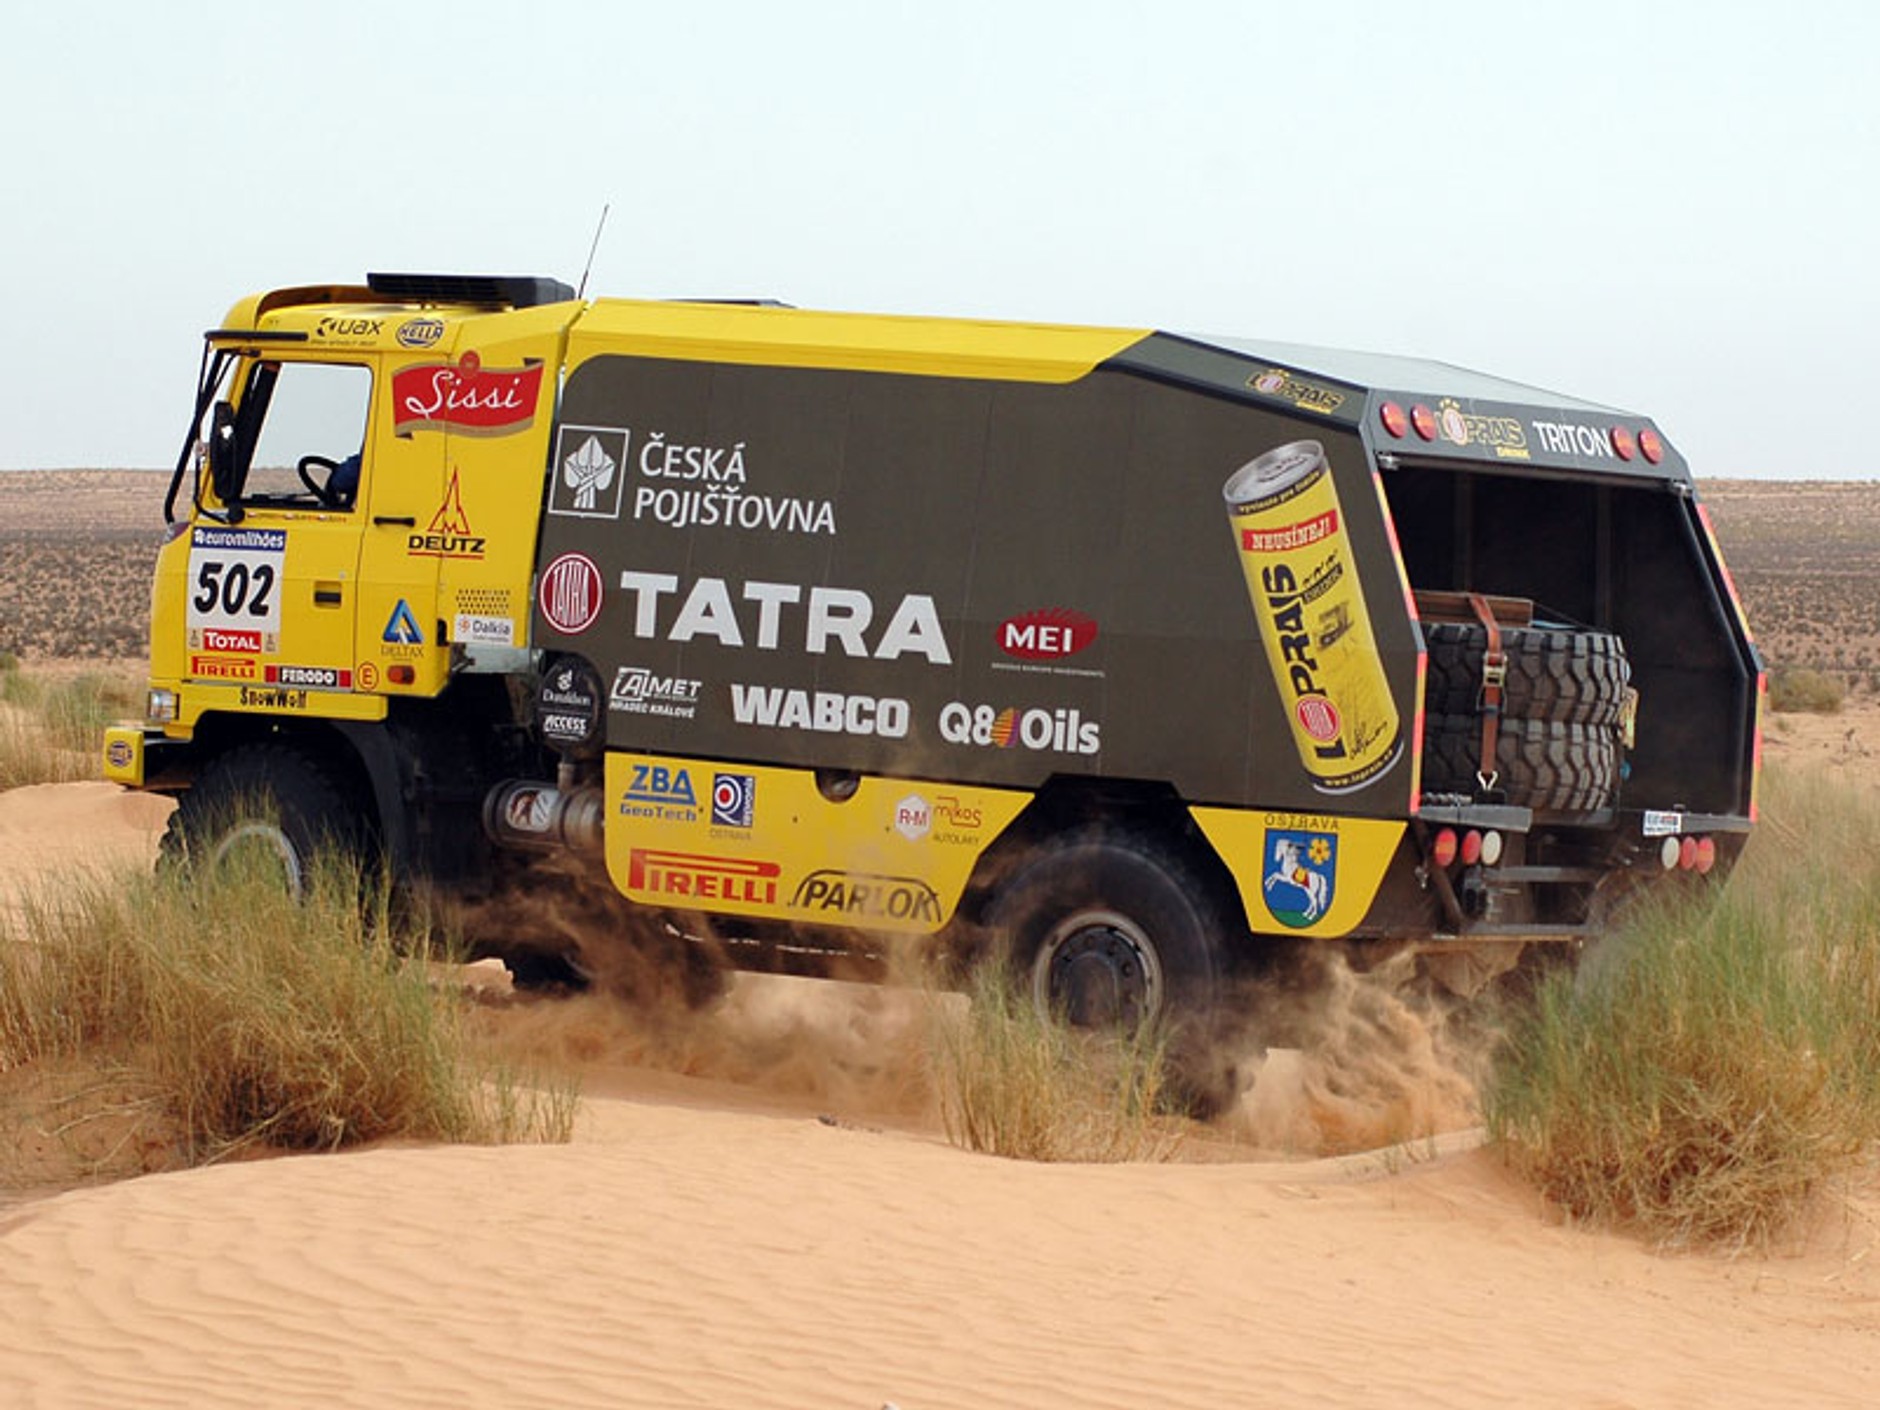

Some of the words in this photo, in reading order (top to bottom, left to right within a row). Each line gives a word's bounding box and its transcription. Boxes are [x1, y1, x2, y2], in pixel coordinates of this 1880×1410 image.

[405, 370, 523, 419] Sissi
[640, 432, 746, 484] ČESKÁ
[1532, 421, 1614, 457] TRITON
[634, 484, 836, 535] POJIŠŤOVNA
[408, 536, 485, 553] DEUTZ
[194, 562, 275, 616] 502
[620, 570, 952, 665] TATRA
[1005, 622, 1072, 653] MEI
[192, 656, 255, 678] PIRELLI
[281, 668, 336, 685] FERODO
[731, 684, 910, 738] WABCO
[629, 765, 696, 802] ZBA
[1264, 813, 1339, 830] OSTRAVA
[629, 848, 781, 904] PIRELLI
[801, 879, 938, 923] PARLOK
